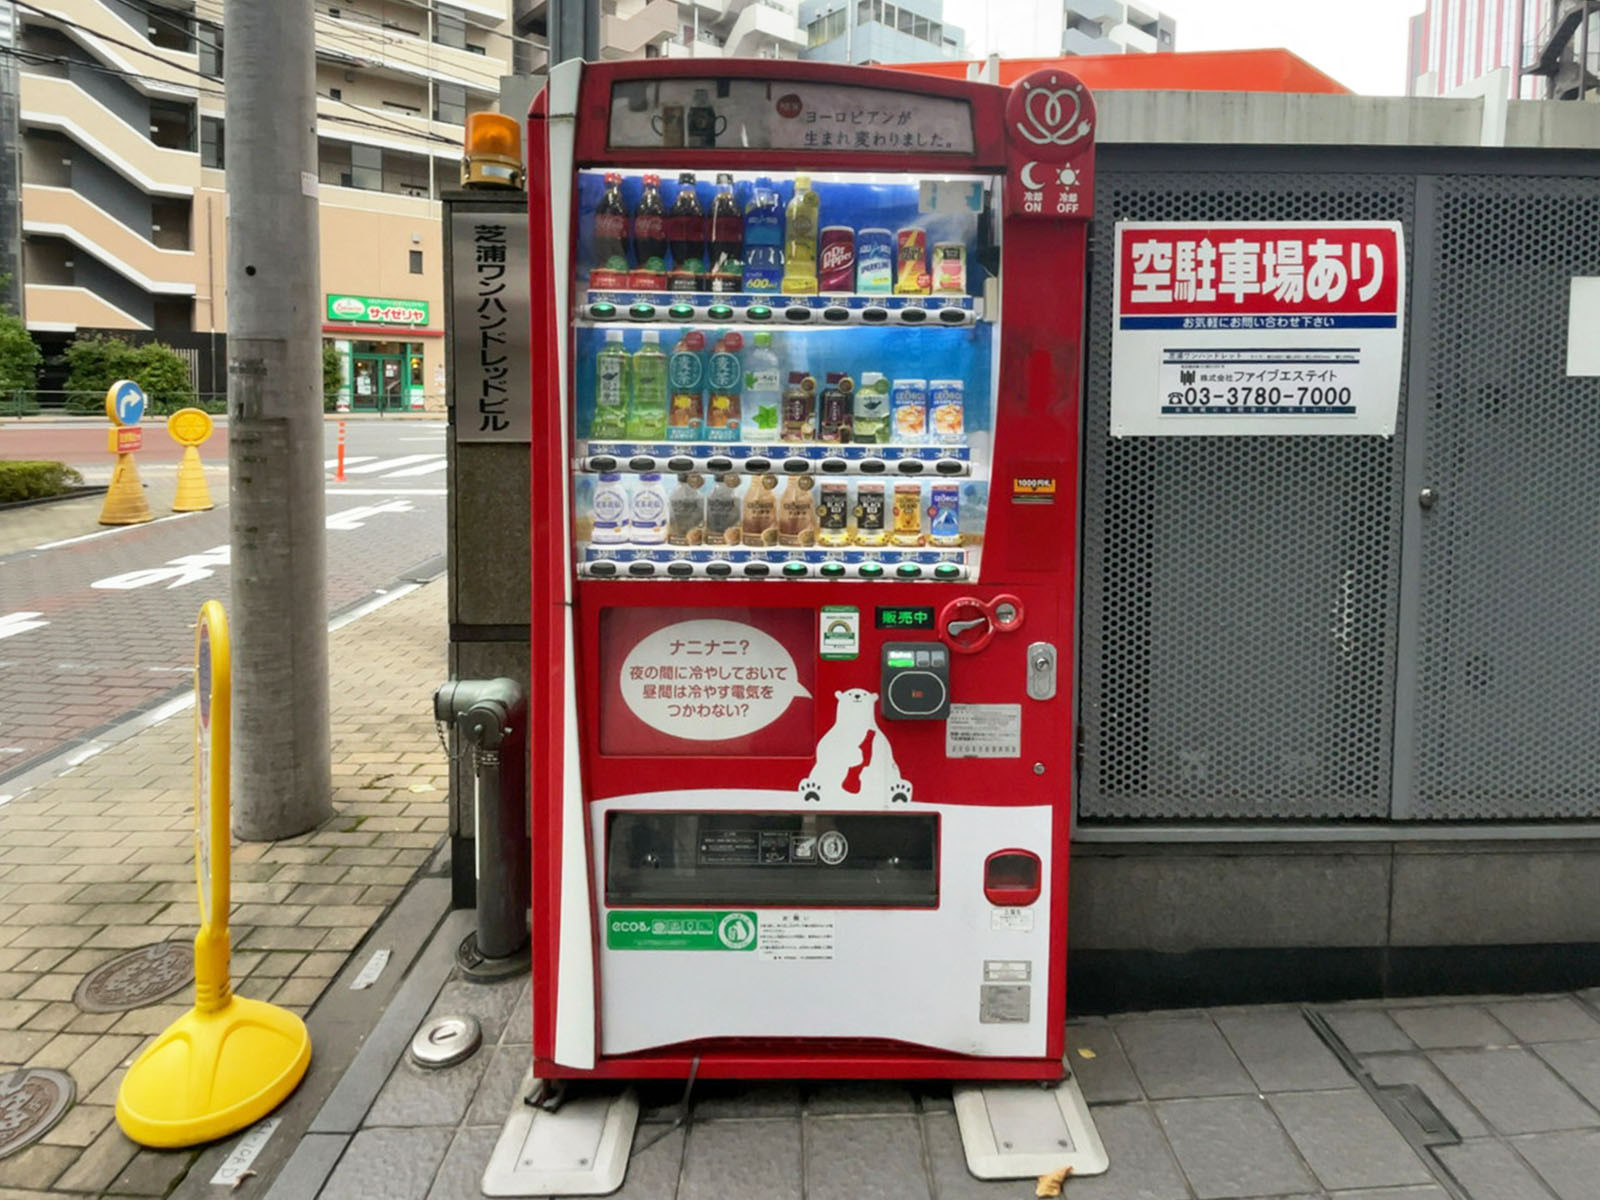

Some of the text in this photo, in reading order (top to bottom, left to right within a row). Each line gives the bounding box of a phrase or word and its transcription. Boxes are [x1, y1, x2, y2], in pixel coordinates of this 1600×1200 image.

[804, 130, 953, 148] 生まれ変わりました。
[1024, 202, 1042, 213] ON
[1057, 203, 1080, 213] OFF
[1131, 238, 1384, 304] 空駐車場あり
[1182, 316, 1335, 329] お気軽にお問い合わせ下さい
[1200, 369, 1338, 383] 株式会社ファイブエステイト
[1185, 387, 1351, 406] 03-3780-7000
[881, 610, 928, 624] 販売中
[629, 666, 788, 680] 夜の間に冷やしておいて
[642, 685, 774, 700] 昼間は冷やす電気を
[667, 703, 750, 718] つかわない?
